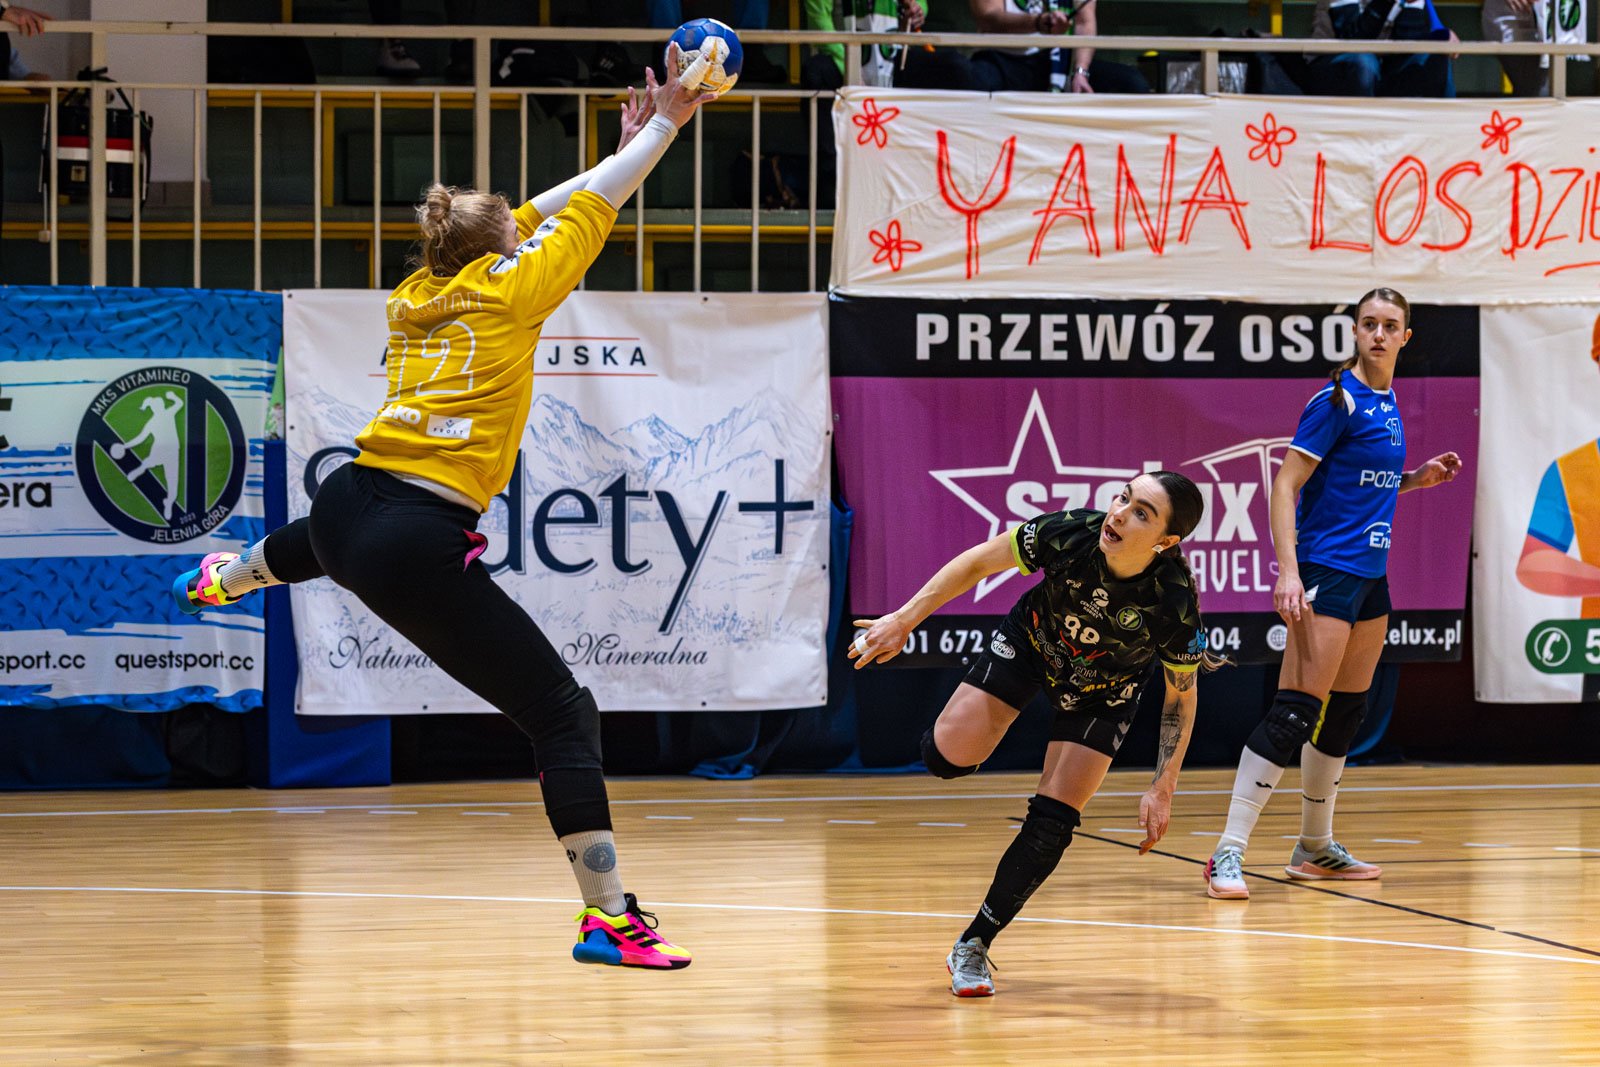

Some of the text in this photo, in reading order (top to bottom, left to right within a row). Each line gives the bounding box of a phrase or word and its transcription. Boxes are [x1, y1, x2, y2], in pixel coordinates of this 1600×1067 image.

[936, 130, 1251, 280] YANA
[1309, 150, 1482, 253] LOS
[915, 302, 1356, 362] PRZEWÓZ OSÓ
[90, 367, 191, 417] MKS VITAMINEO
[150, 503, 230, 542] JELENIA GÓRA
[1195, 550, 1272, 593] AVEL
[328, 631, 708, 670] Natura Mineralna
[902, 629, 984, 654] 01 672
[1204, 626, 1242, 651] 04
[1384, 619, 1462, 652] elux.pl
[0, 650, 255, 674] sport.cc questsport.cc
